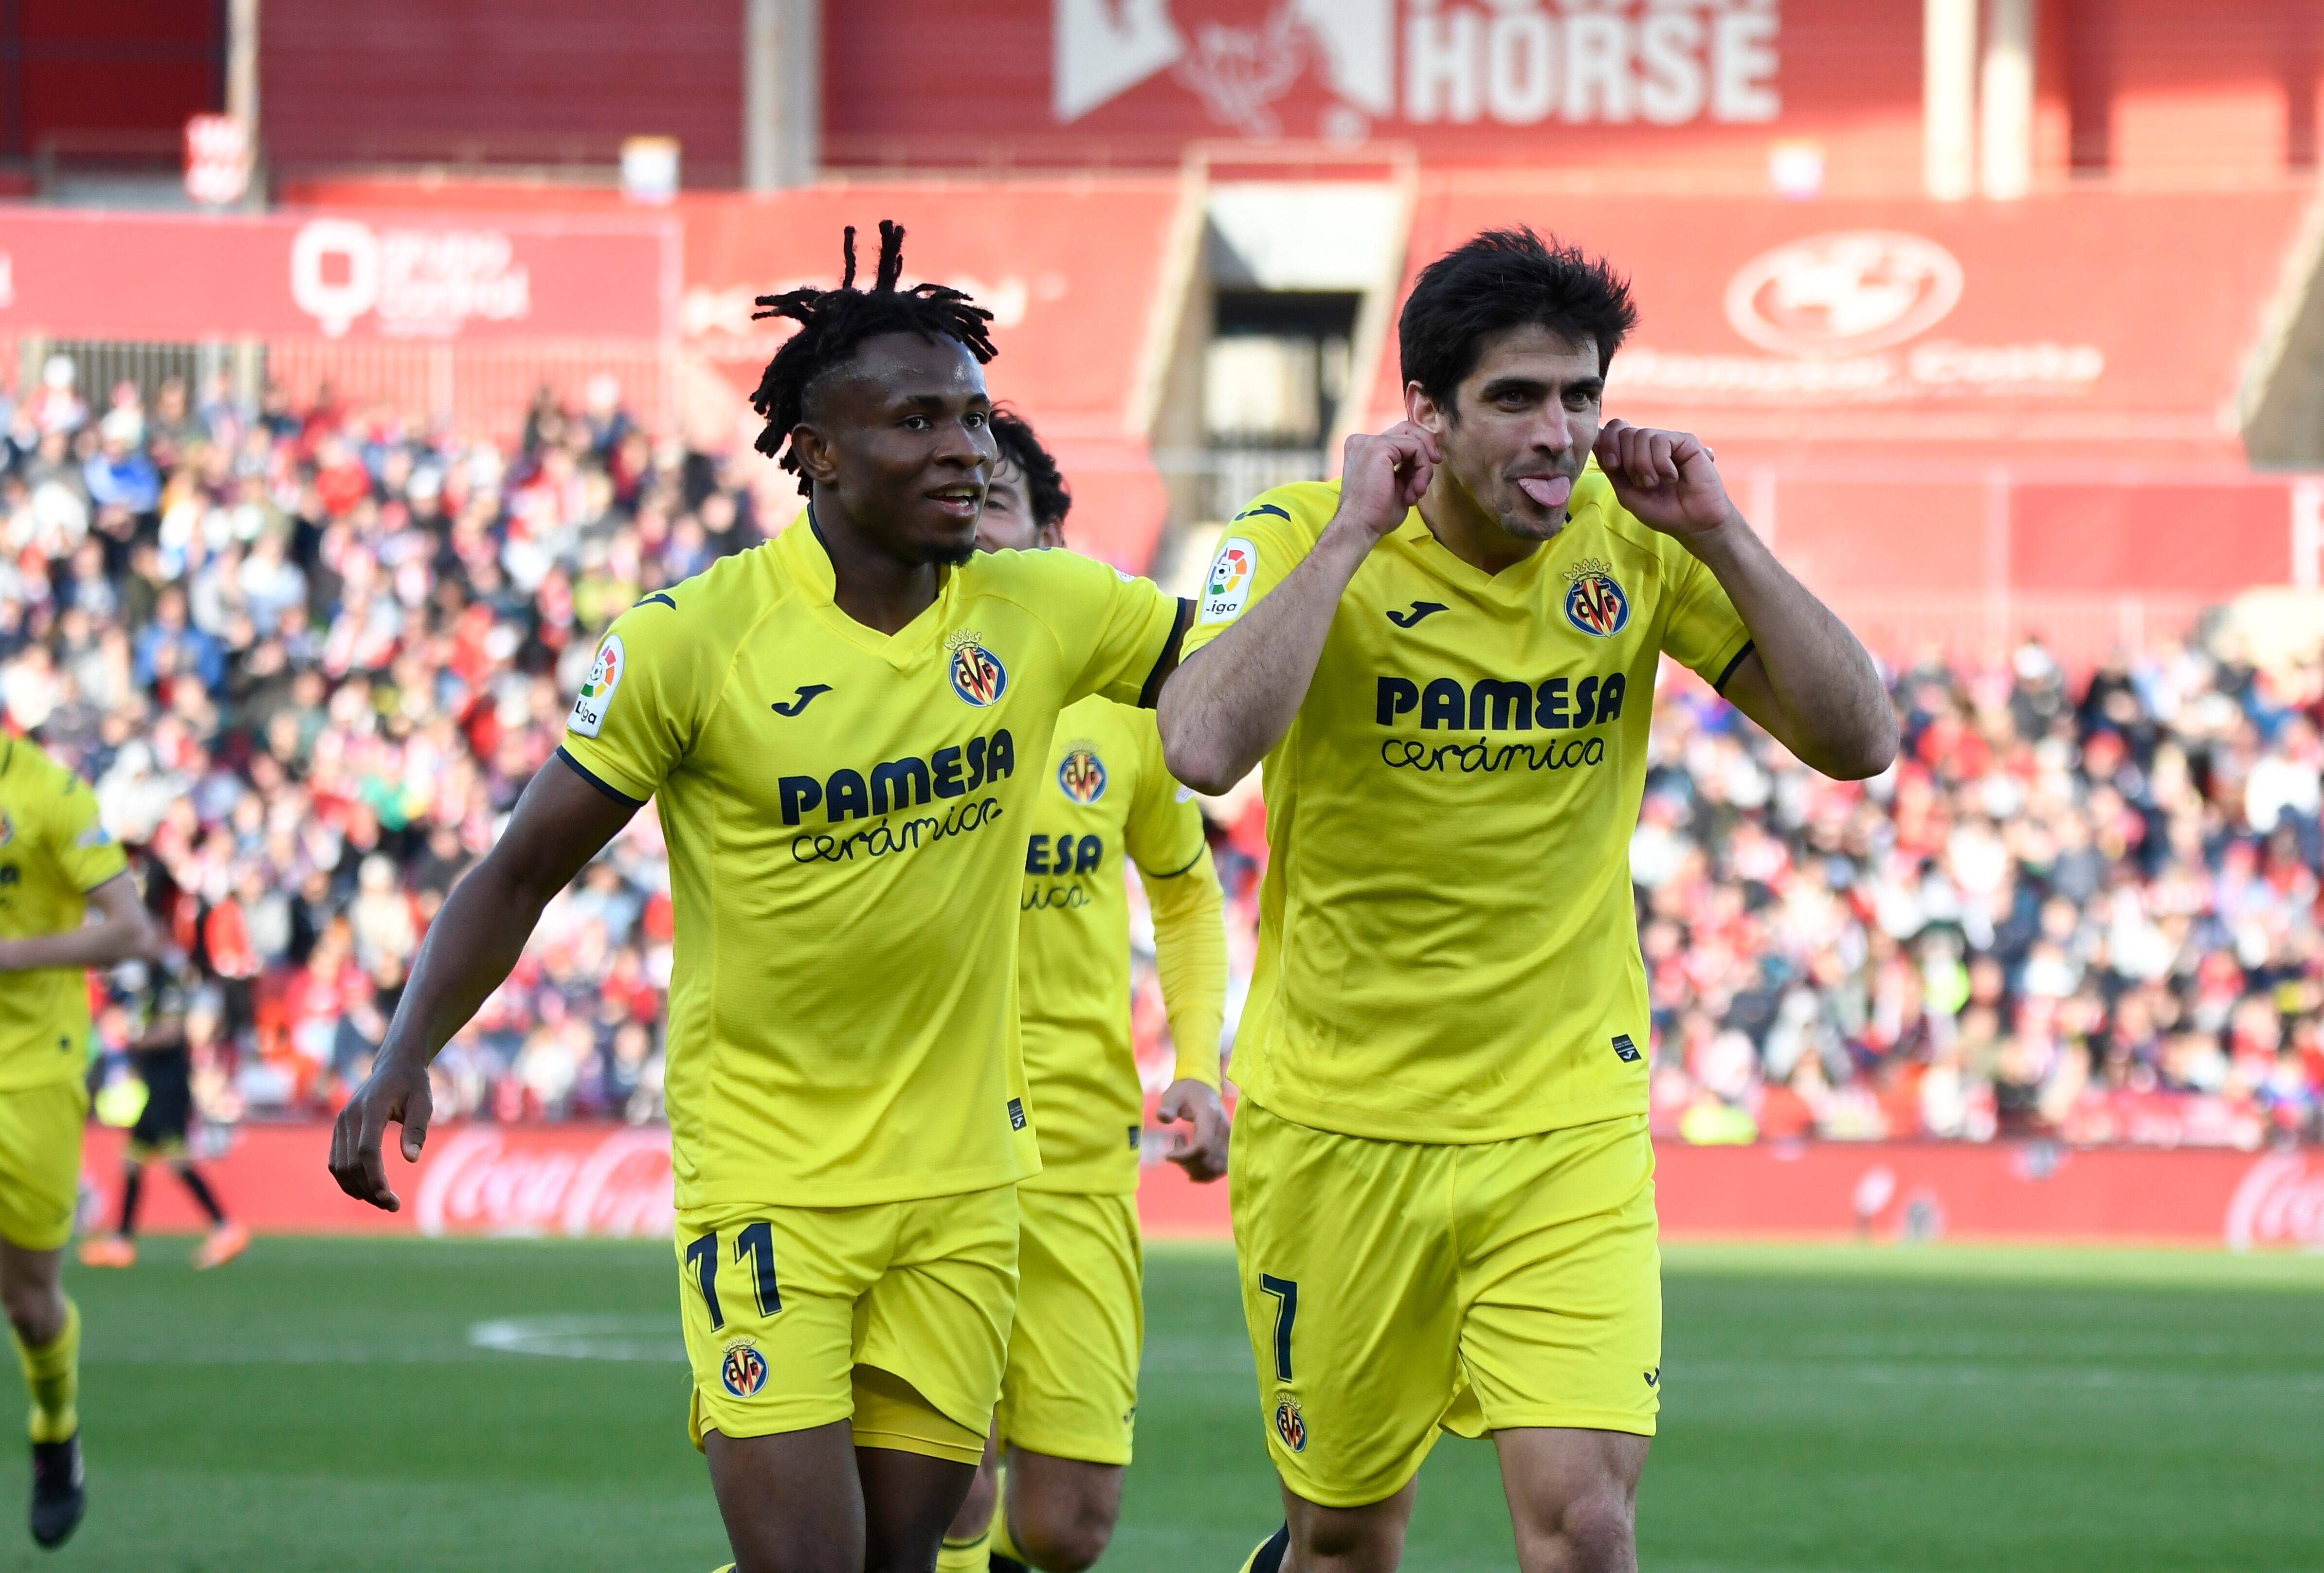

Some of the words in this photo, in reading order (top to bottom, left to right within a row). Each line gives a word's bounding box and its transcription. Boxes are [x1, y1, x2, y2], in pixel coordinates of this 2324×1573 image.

[1403, 12, 1781, 124] HORSE
[575, 701, 597, 725] Liga
[1377, 672, 1626, 730] PAMESA
[779, 728, 1014, 825] PAMESA
[1381, 737, 1604, 772] cerámica
[1026, 834, 1103, 875] ESA
[1259, 1272, 1297, 1384] 7
